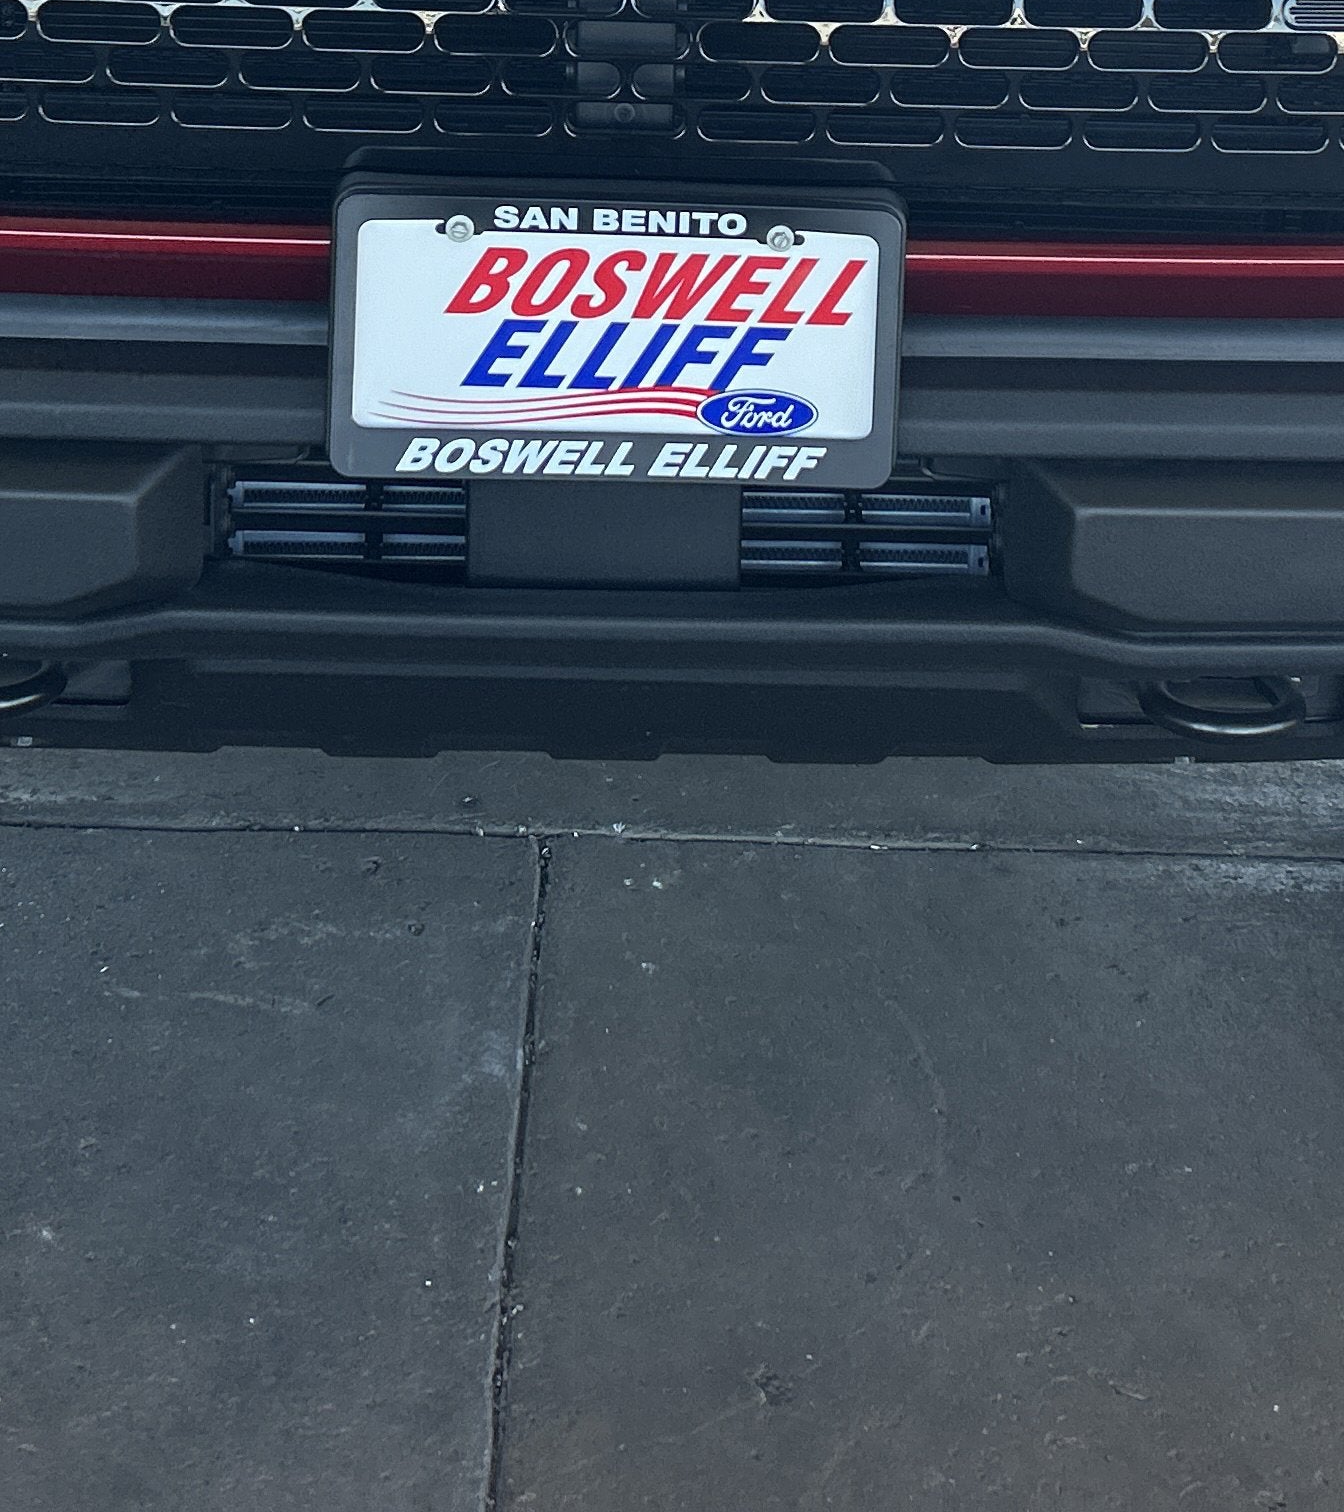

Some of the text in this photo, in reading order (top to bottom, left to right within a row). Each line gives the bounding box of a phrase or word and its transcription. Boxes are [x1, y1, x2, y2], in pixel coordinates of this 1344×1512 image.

[494, 205, 748, 237] SAN BENITO
[443, 246, 868, 326] BOSWELL
[460, 319, 793, 392] ELLIFF
[719, 396, 793, 430] Ford
[394, 437, 827, 481] BOSWELL ELLIFF
